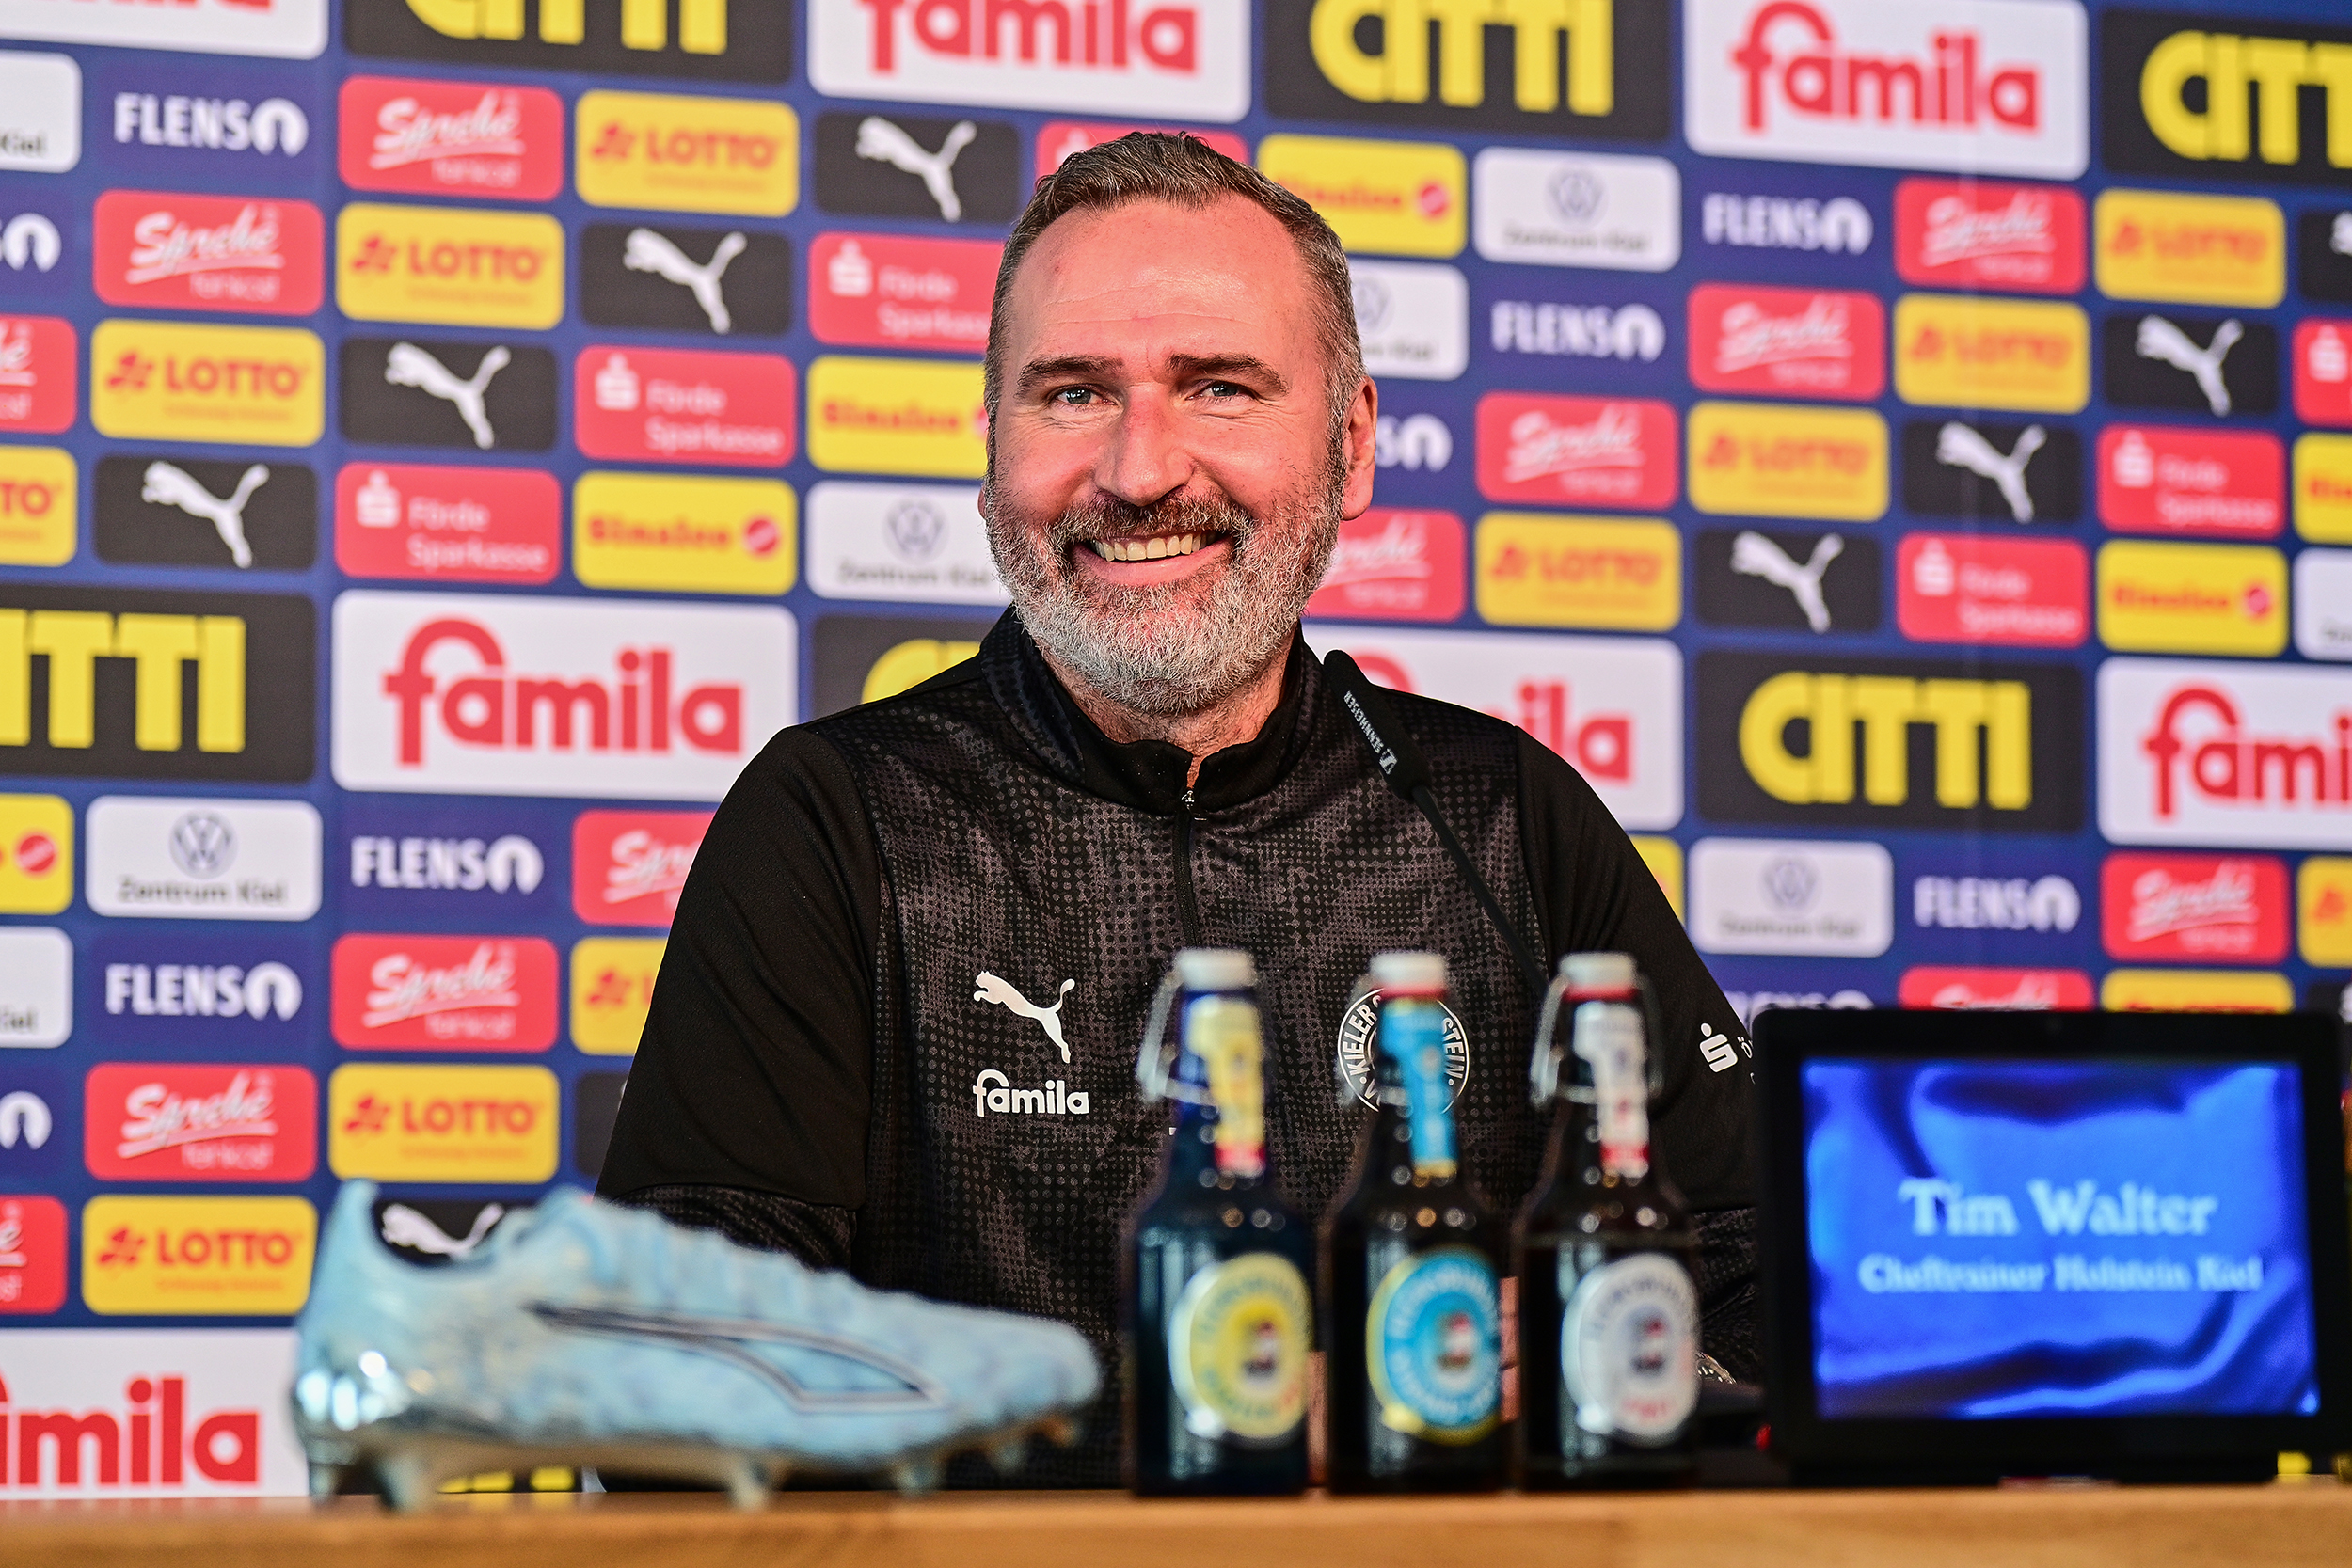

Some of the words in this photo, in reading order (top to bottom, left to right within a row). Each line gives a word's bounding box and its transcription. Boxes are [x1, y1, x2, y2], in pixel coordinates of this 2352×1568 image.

[1731, 2, 2039, 135] famila
[645, 132, 780, 170] LOTTO
[406, 237, 545, 284] LOTTO
[166, 356, 305, 398] LOTTO
[645, 418, 785, 456] Sparkasse
[407, 495, 488, 533] Förde
[407, 533, 549, 575] Sparkasse
[384, 616, 746, 768] famila
[1739, 672, 2032, 810] CITTI
[116, 877, 230, 905] Zentrum
[236, 879, 286, 904] Kiel
[1343, 1004, 1378, 1076] KIELER
[973, 1069, 1089, 1117] famila
[402, 1097, 539, 1137] LOTTO
[1898, 1177, 2020, 1237] Tim
[2026, 1178, 2218, 1237] Walter
[156, 1230, 297, 1268] LOTTO
